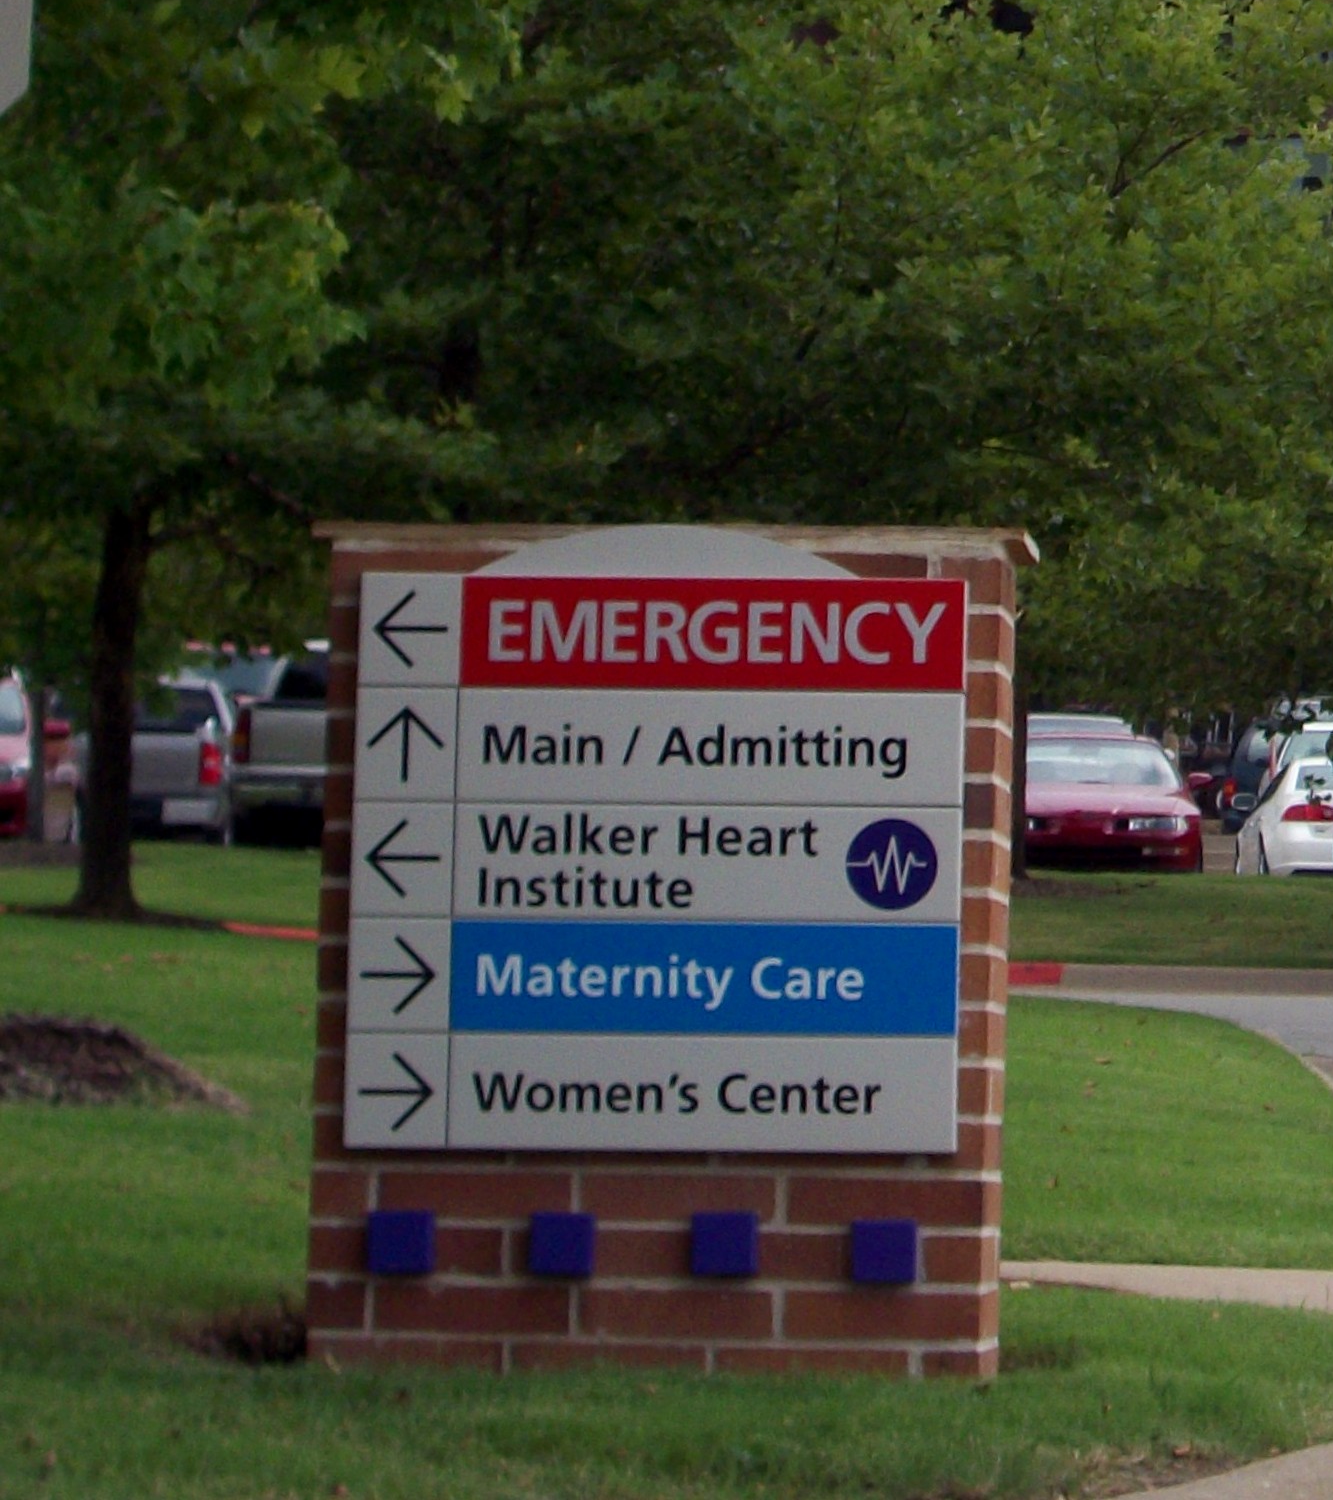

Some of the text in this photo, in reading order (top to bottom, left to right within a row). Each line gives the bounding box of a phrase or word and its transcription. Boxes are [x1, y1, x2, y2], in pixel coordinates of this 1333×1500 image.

[487, 598, 948, 665] EMERGENCY
[481, 723, 909, 779] Main / Admitting
[478, 812, 819, 857] Walker Heart
[477, 865, 694, 909] Institute
[476, 954, 866, 1009] Maternity Care
[473, 1071, 883, 1115] Women’s Center
